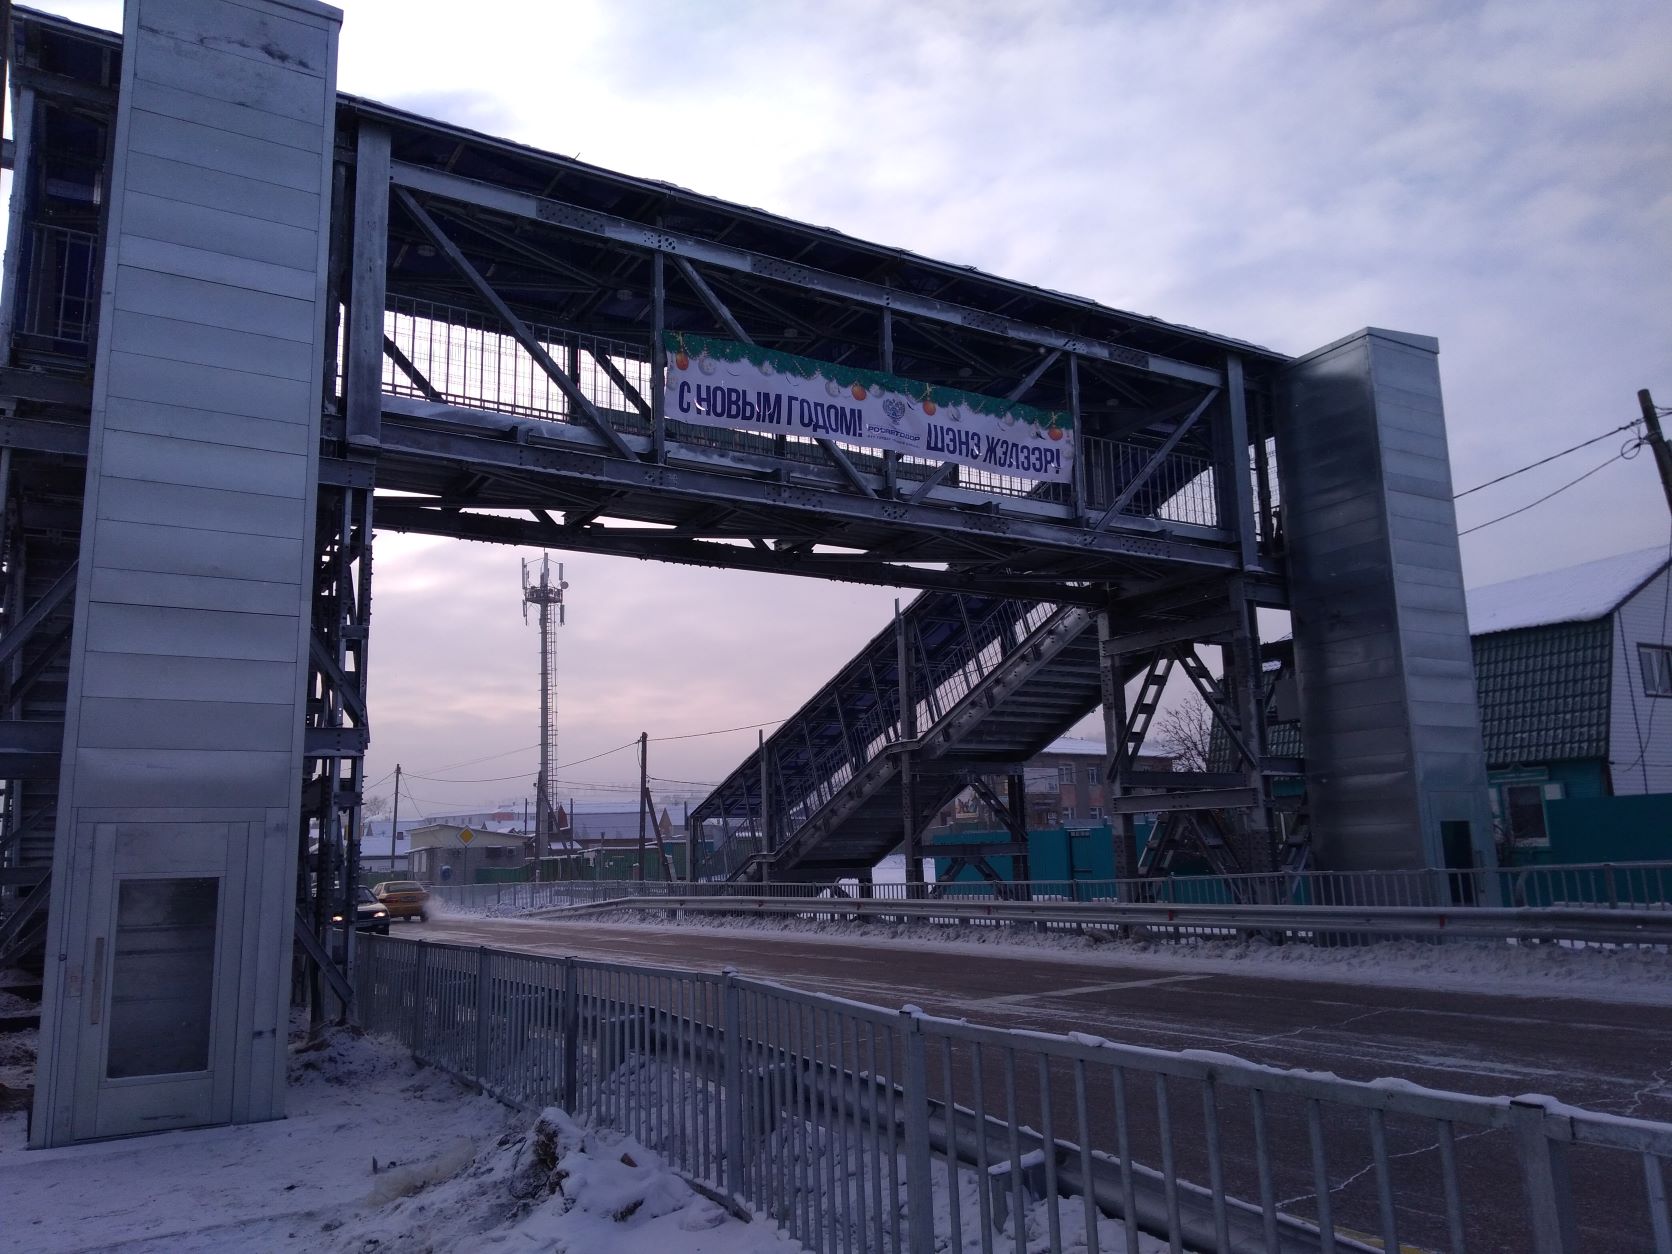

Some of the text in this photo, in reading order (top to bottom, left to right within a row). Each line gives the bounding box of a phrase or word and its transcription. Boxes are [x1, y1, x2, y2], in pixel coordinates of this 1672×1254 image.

[679, 381, 863, 438] С НОВЫМ ГОДОМ!
[926, 423, 1062, 475] ШЭНЭ ЖЭЛЭЭР!
